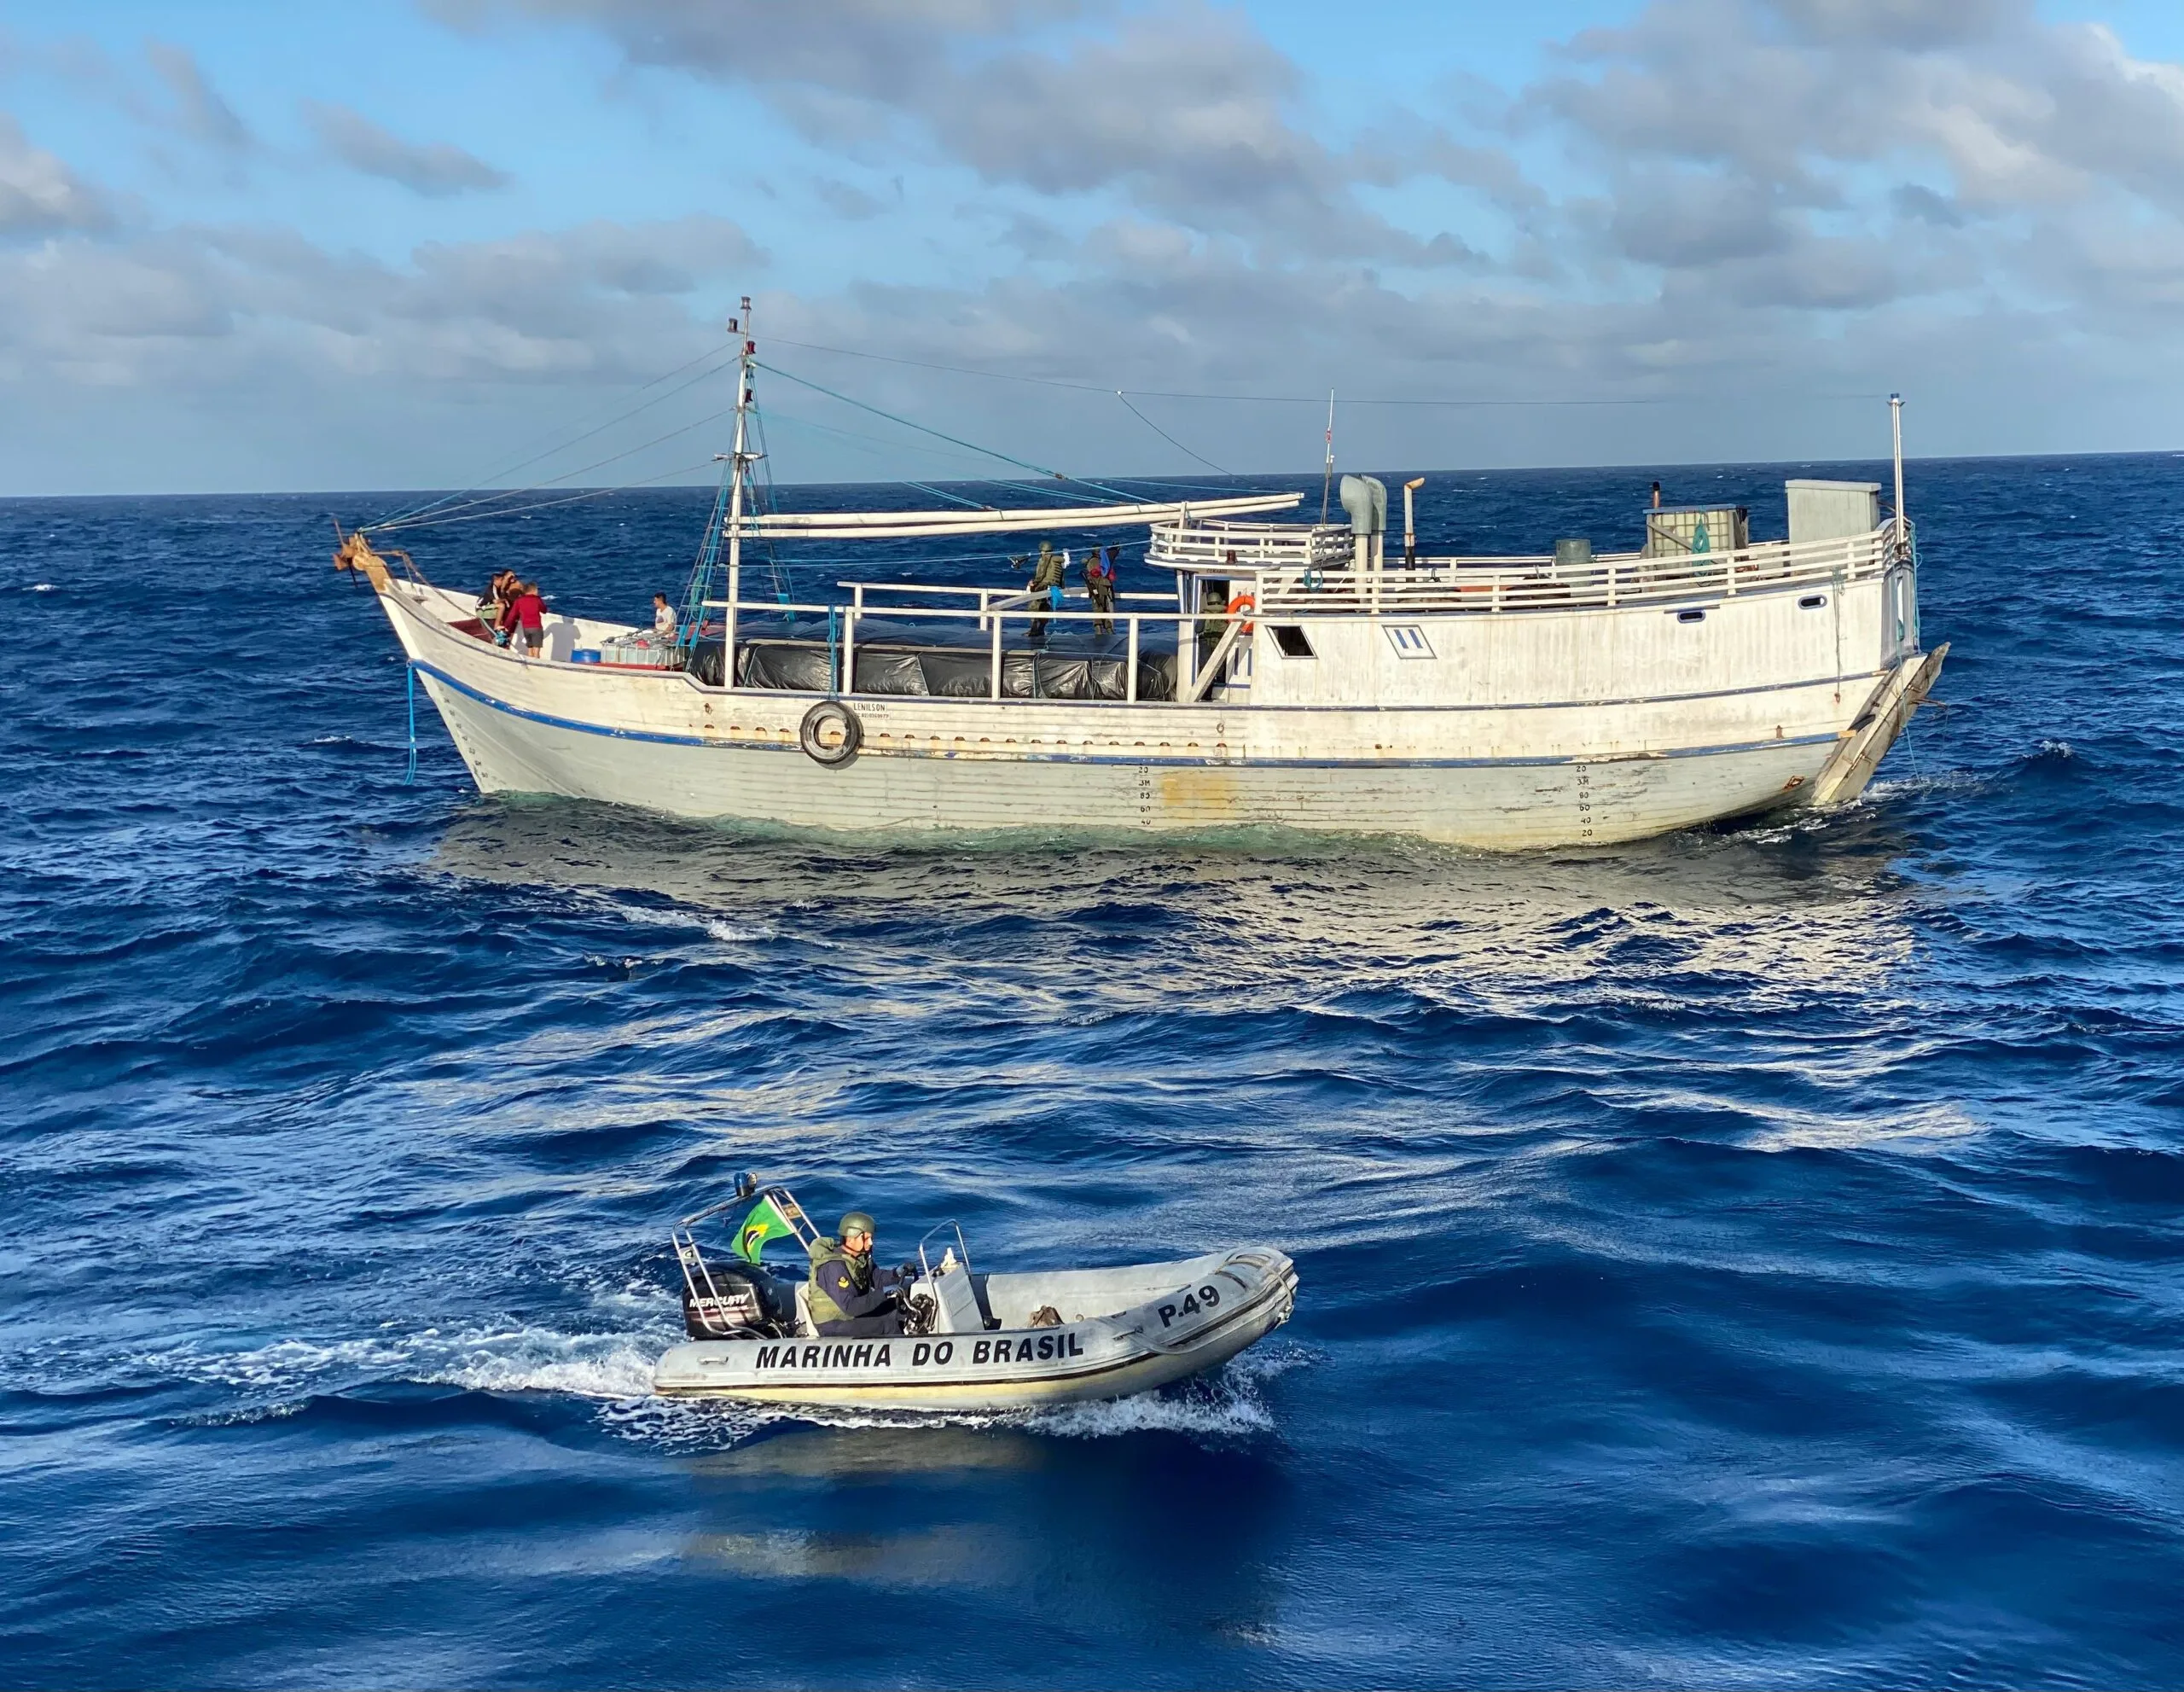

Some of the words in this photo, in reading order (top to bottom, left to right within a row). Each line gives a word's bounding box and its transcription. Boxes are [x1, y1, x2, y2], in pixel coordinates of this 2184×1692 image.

[689, 1292, 750, 1308] MERCURY
[1158, 1285, 1220, 1328] P.49
[756, 1344, 891, 1369] MARINHA
[912, 1341, 954, 1366] DO
[972, 1332, 1084, 1364] BRASIL
